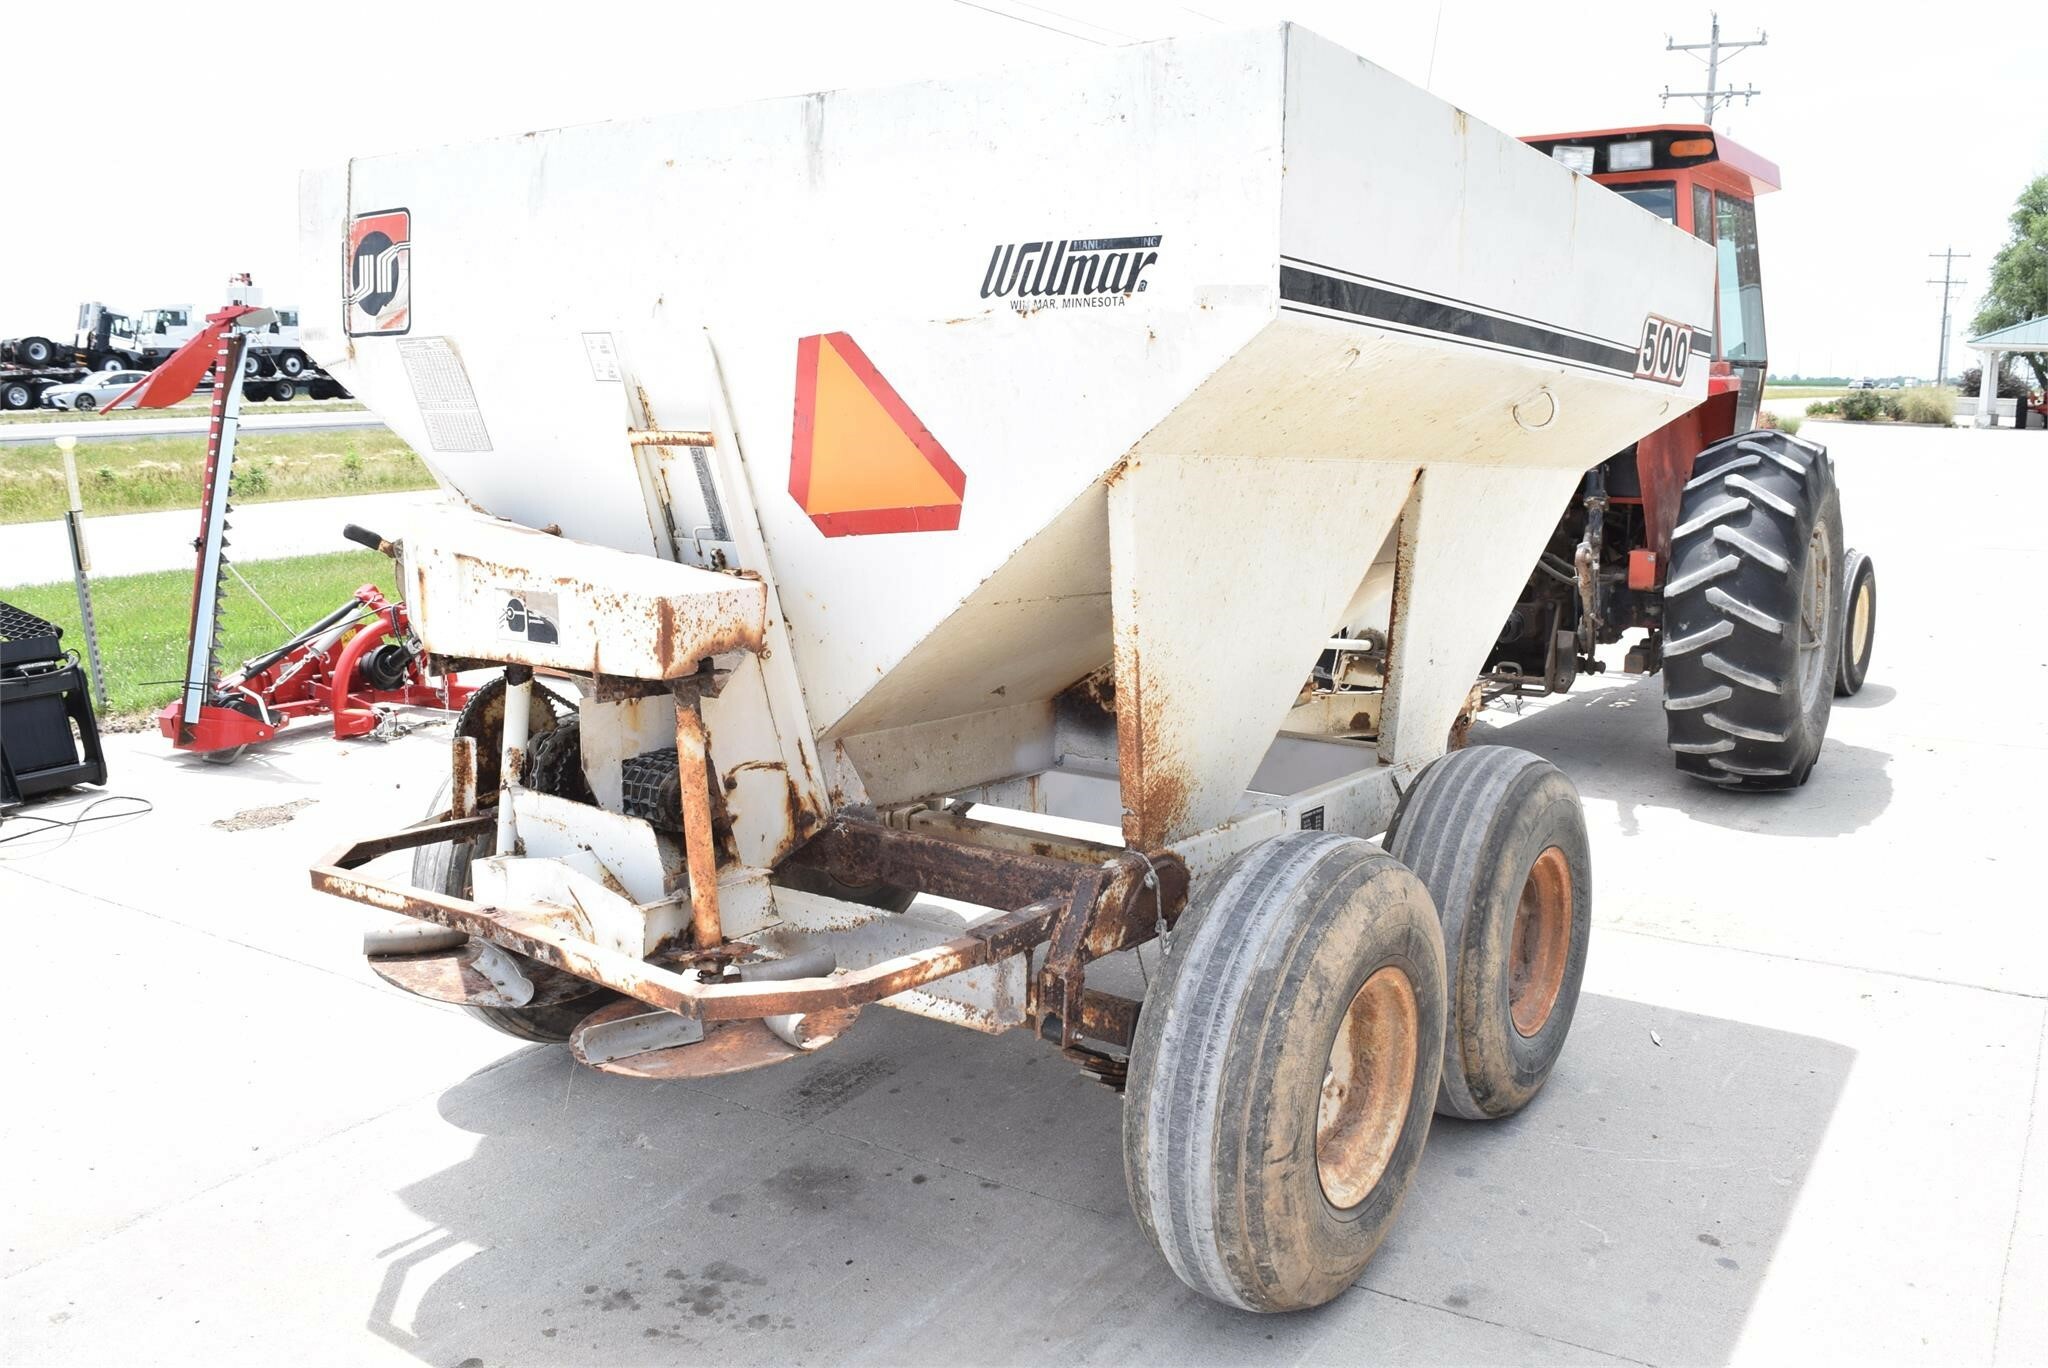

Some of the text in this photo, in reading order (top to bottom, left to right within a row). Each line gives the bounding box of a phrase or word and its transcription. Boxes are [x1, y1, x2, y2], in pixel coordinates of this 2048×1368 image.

[980, 240, 1158, 299] Willmar
[1062, 296, 1125, 309] MINNESOTA
[1642, 322, 1688, 378] 500
